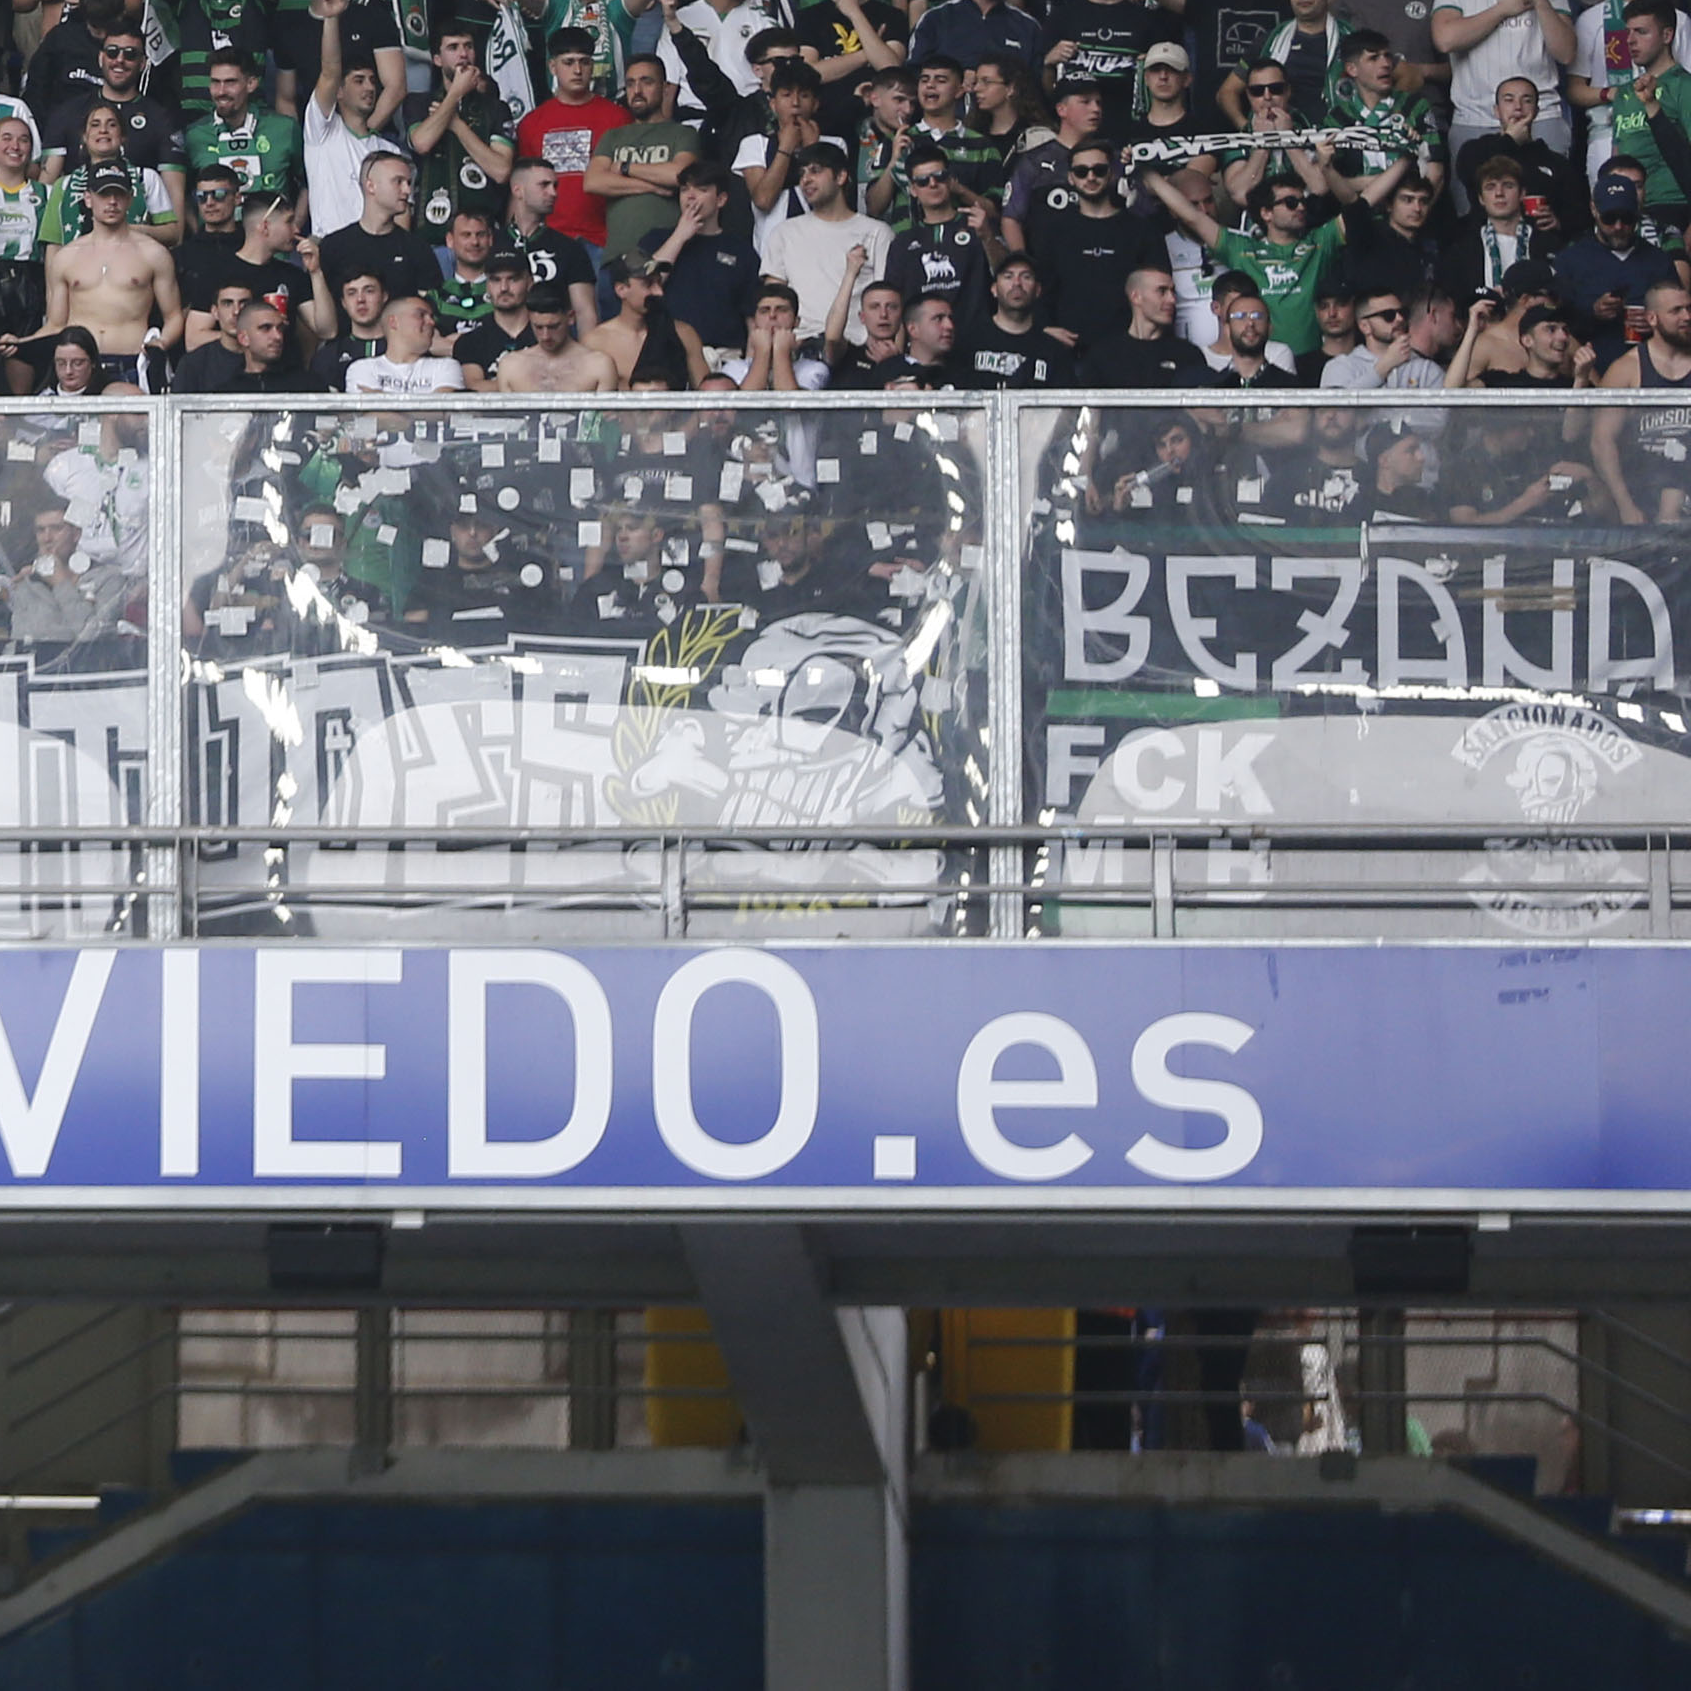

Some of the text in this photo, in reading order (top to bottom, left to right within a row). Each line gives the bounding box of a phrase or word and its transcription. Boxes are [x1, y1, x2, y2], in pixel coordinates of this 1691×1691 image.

[1131, 125, 1380, 161] OLVEREMOS
[1293, 488, 1343, 514] elle
[1058, 548, 1676, 693] BEZANA
[1461, 702, 1635, 767] SANCIONADOS
[1045, 722, 1275, 815] FCK
